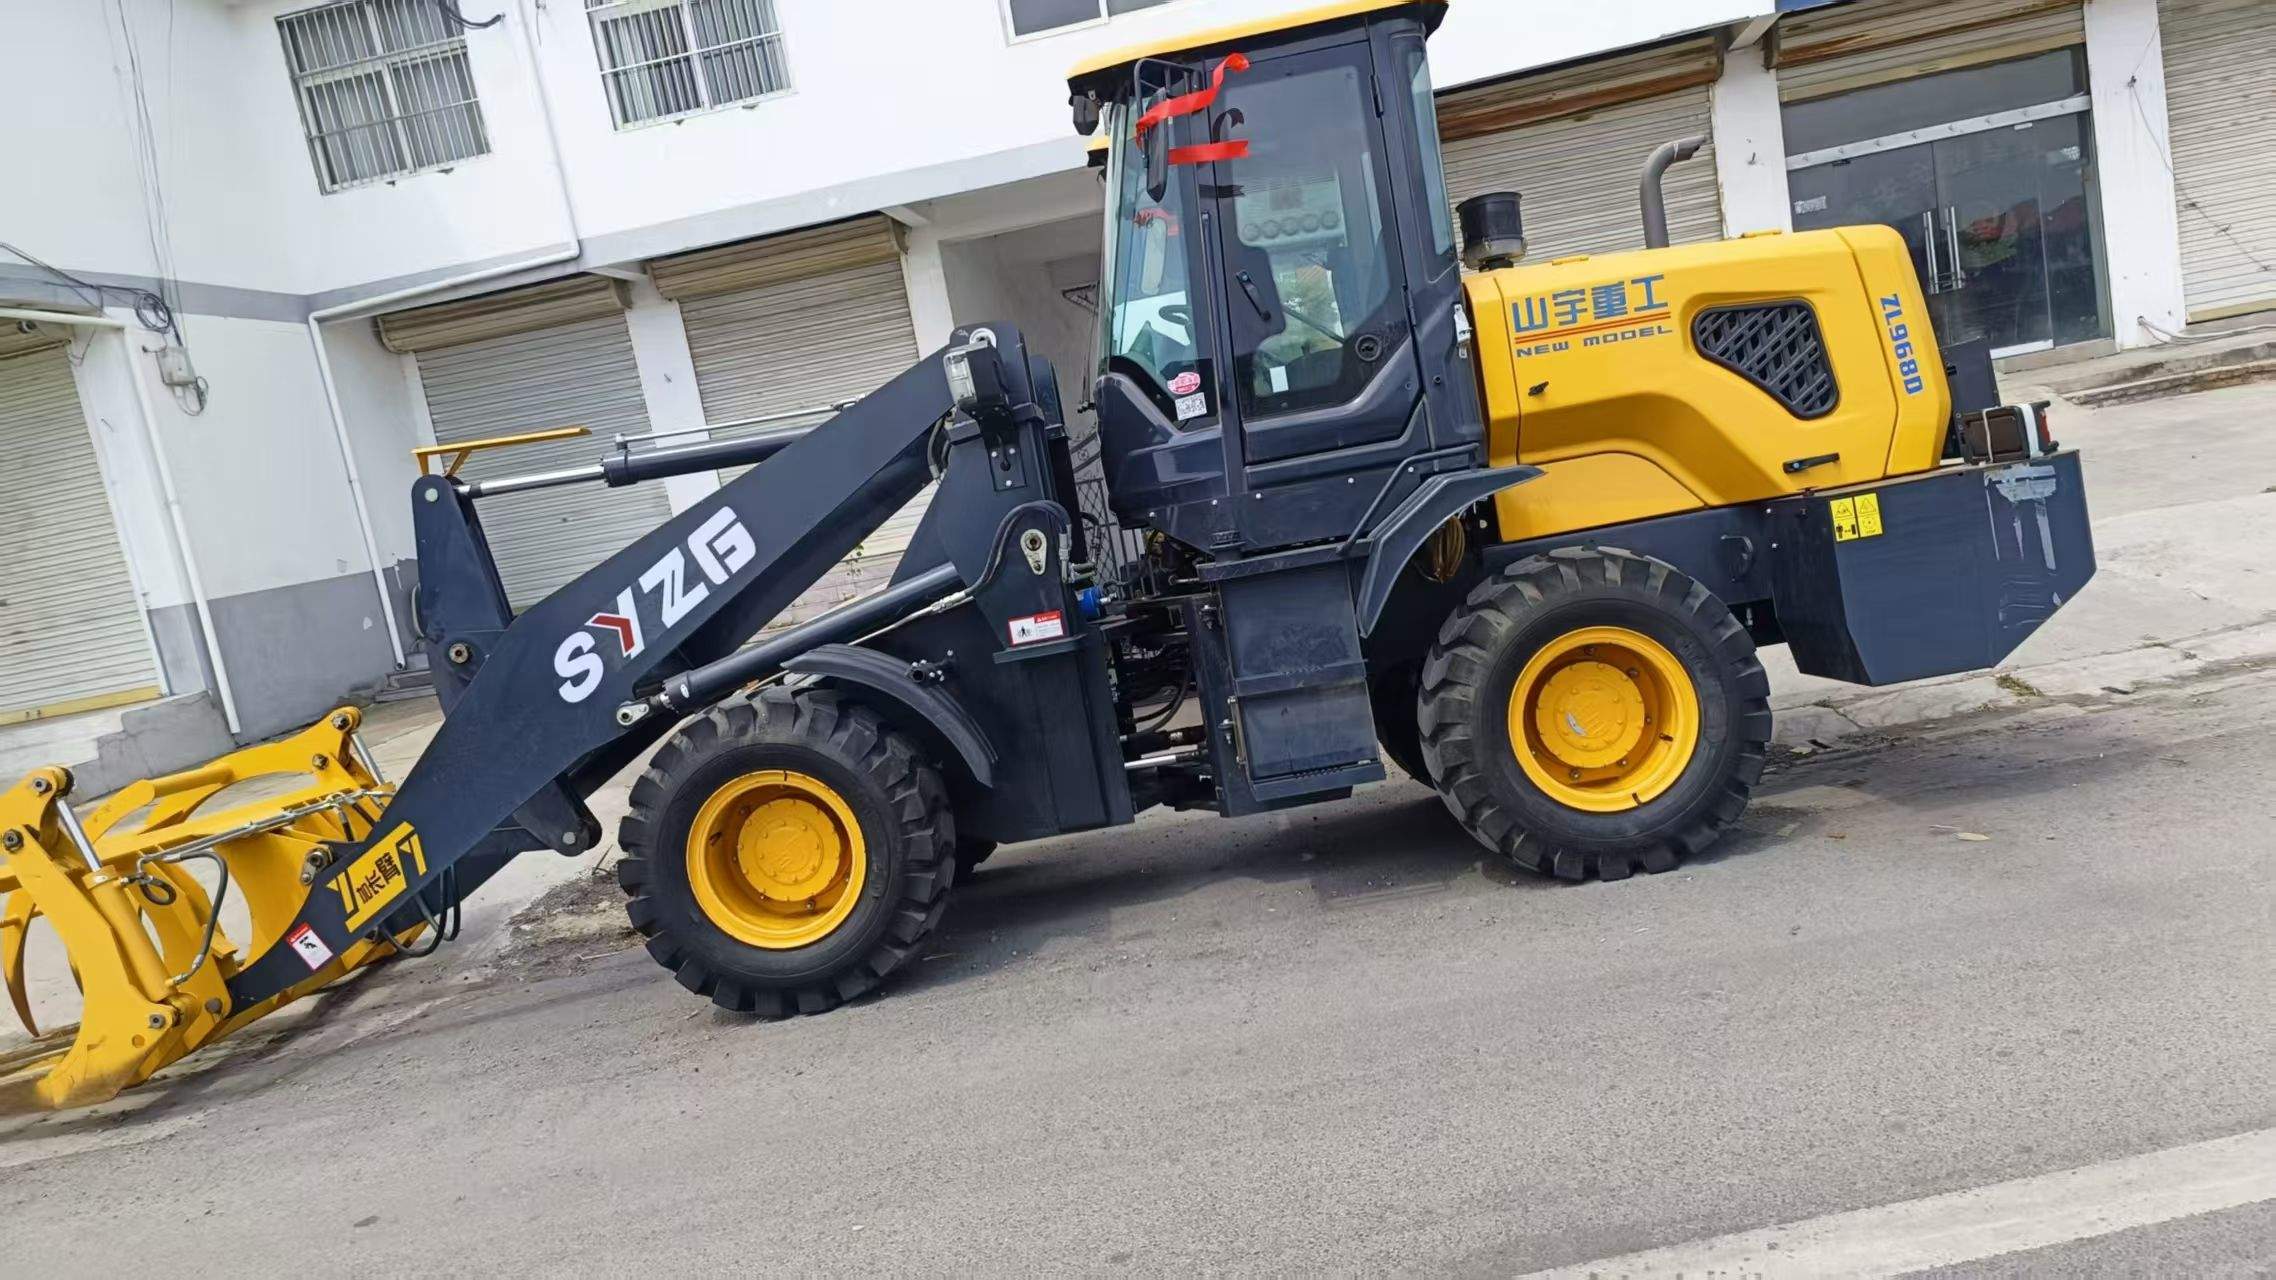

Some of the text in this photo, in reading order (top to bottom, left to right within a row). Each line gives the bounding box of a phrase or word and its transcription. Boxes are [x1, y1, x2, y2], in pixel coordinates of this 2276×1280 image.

[1512, 274, 1669, 333] 山宇重工
[1516, 325, 1672, 358] NEW MODEL
[1880, 293, 1923, 395] ZL968D
[554, 506, 757, 703] SYZG
[356, 852, 401, 904] 加长臂
